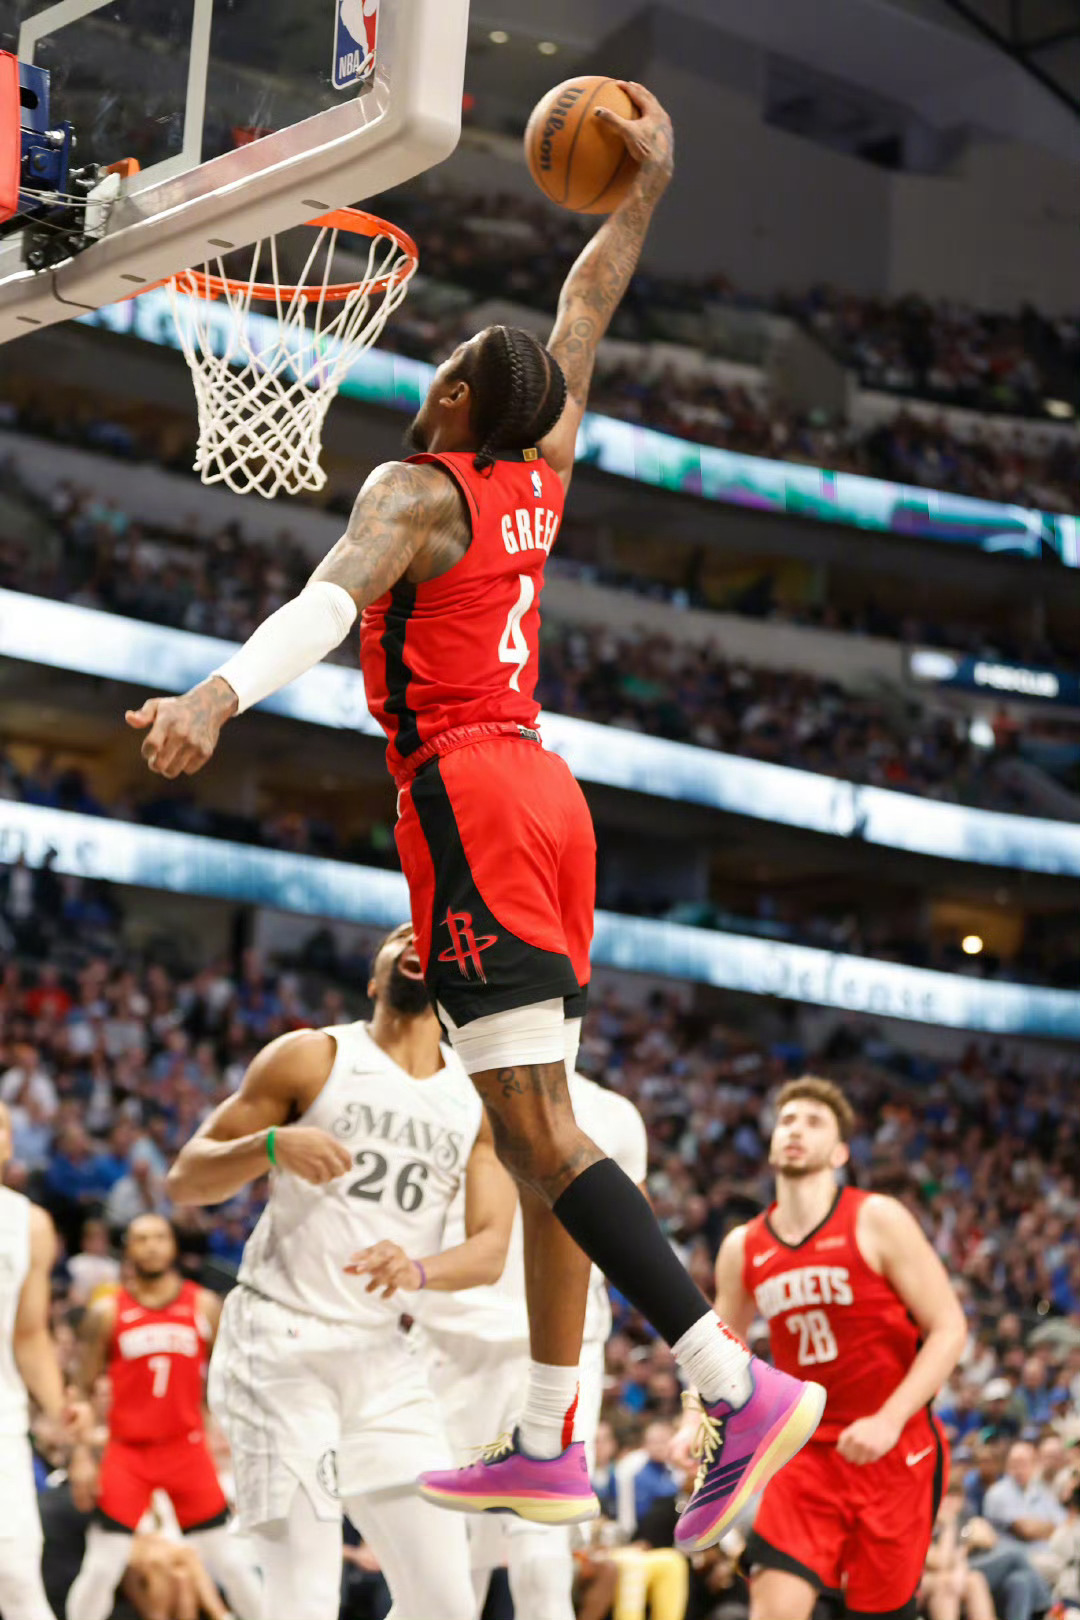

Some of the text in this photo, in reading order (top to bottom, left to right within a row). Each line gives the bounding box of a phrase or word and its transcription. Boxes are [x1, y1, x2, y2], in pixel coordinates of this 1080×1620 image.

[339, 49, 360, 79] NBA
[540, 87, 585, 170] Wilson
[498, 574, 534, 692] 4
[331, 1102, 463, 1171] MAVS
[347, 1149, 428, 1212] 26
[785, 1309, 838, 1366] 28
